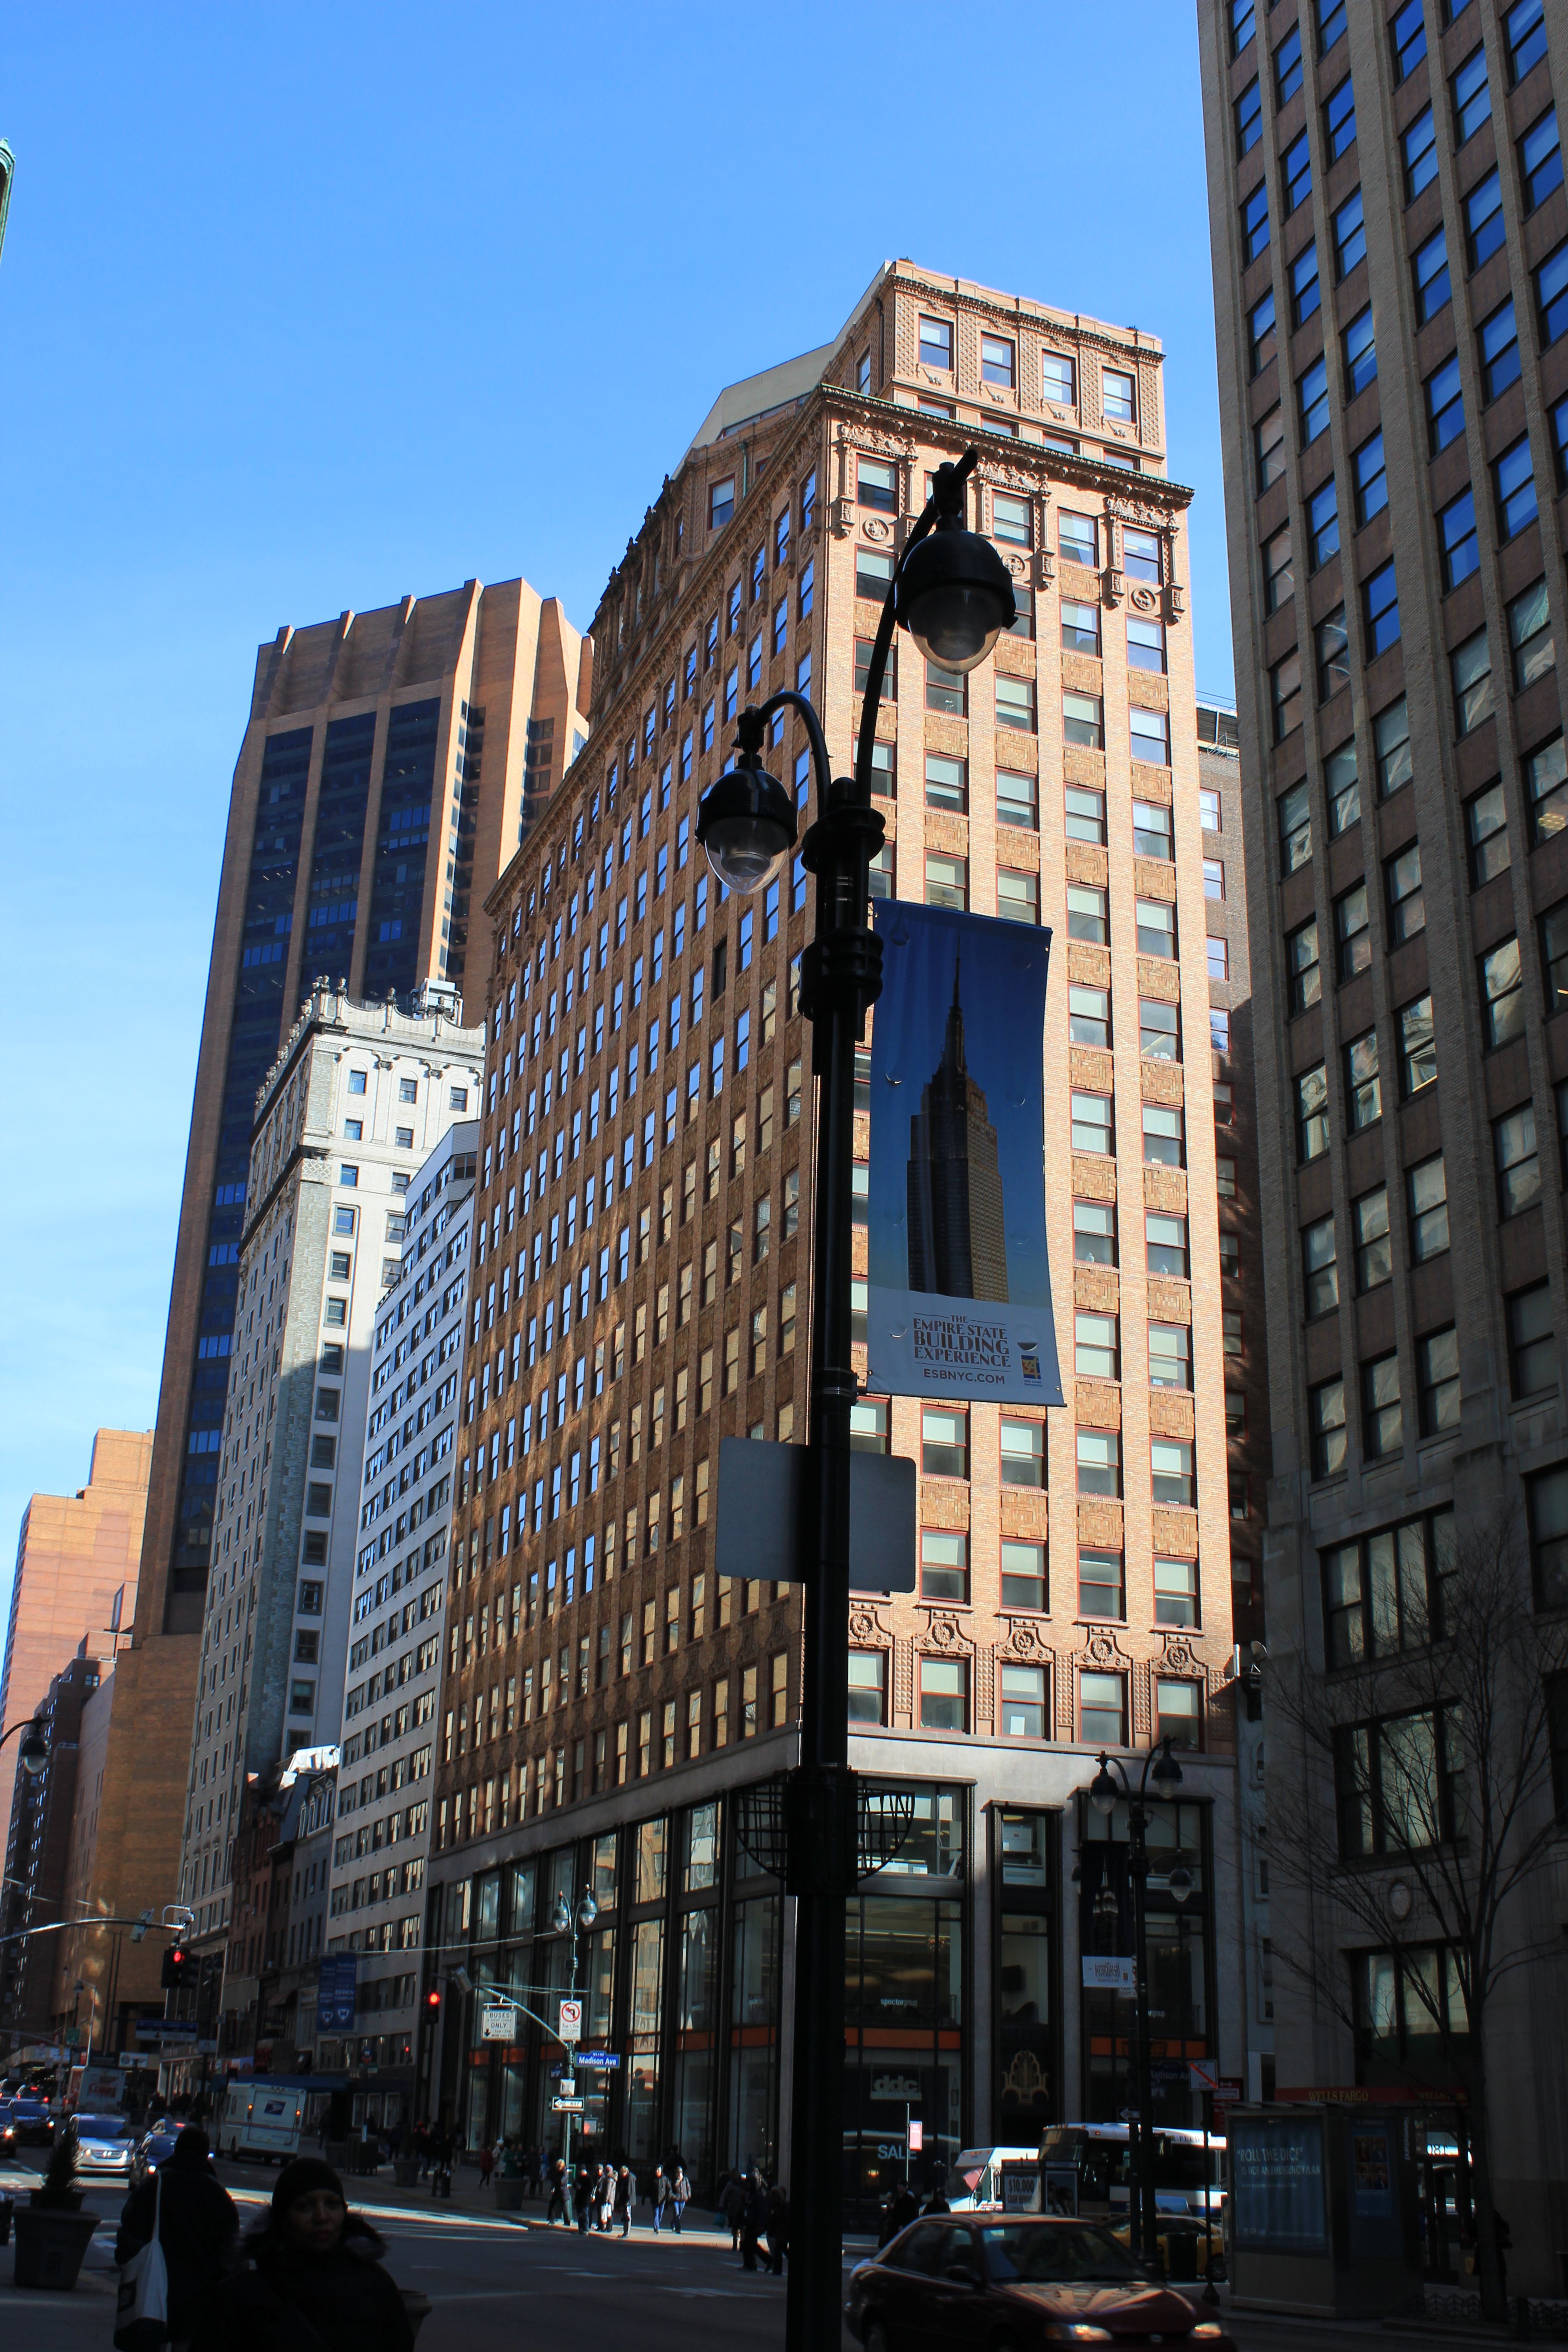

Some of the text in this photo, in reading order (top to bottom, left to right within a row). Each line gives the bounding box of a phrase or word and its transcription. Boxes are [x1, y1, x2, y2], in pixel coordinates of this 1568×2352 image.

[950, 1315, 968, 1323] THE
[913, 1318, 1007, 1340] EMPIRE STATE
[914, 1330, 1009, 1355] BUILDING
[914, 1346, 1011, 1367] EXPERIENCE
[924, 1368, 1005, 1384] ESBNYC.COM
[880, 1998, 917, 2008] spectorgroup
[578, 2056, 616, 2065] Madison Ave
[1180, 2071, 1189, 2080] Av
[874, 2074, 918, 2092] ddc
[1308, 2090, 1368, 2102] WELLS FARGO
[877, 2144, 917, 2160] SALE
[1262, 2148, 1278, 2162] THE
[1241, 2165, 1320, 2175] IS NOT AN EMERGENCY PLAN
[1009, 2178, 1034, 2194] $10,000
[1007, 2194, 1018, 2203] CASH
